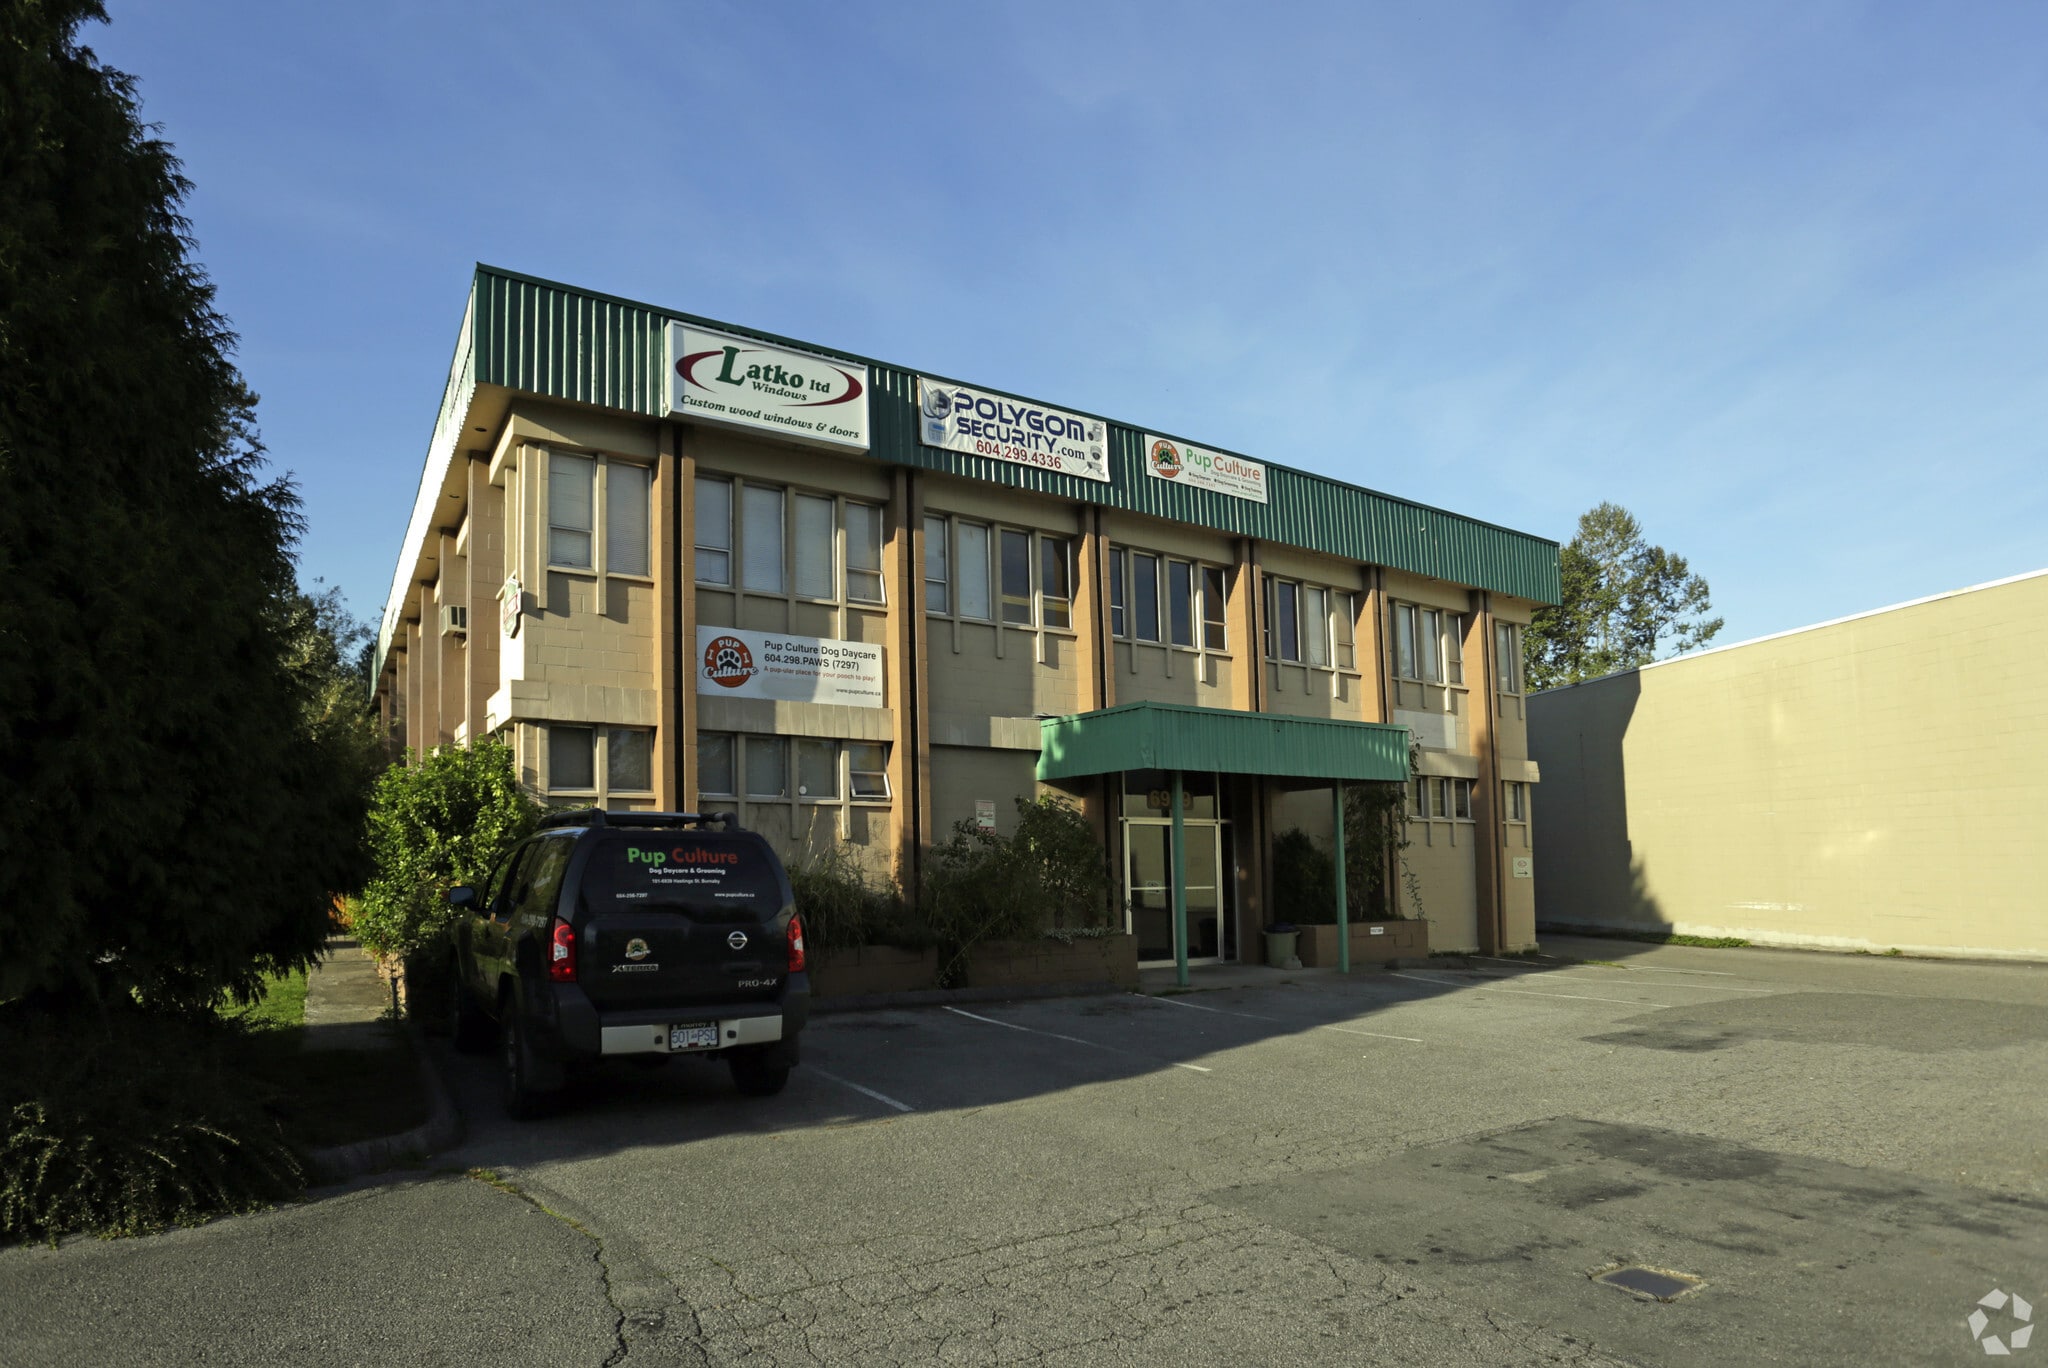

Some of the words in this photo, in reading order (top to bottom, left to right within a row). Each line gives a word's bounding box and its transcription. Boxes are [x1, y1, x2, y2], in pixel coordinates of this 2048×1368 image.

[716, 346, 804, 388] Latko
[810, 379, 830, 394] ltd
[752, 382, 808, 401] Windows
[681, 395, 726, 413] Custom
[729, 406, 761, 419] wood
[764, 412, 813, 430] windows
[816, 422, 827, 432] &
[829, 425, 859, 439] doors
[957, 416, 1057, 454] SECURITY
[976, 440, 1061, 469] 604.299.4336
[1186, 448, 1212, 472] Pup
[1214, 456, 1260, 480] Culture
[718, 639, 740, 649] PUP
[764, 640, 782, 651] Pup
[785, 643, 818, 654] Culture
[821, 646, 839, 657] Dog
[842, 648, 877, 660] Daycare
[764, 654, 829, 667] 604.298.PAWS
[832, 659, 859, 671] (7297)
[702, 665, 759, 679] Culture
[770, 667, 794, 675] pup-ular
[837, 672, 854, 680] pooch
[836, 688, 881, 696] www.pupculture.ca
[1150, 790, 1191, 808] 699
[627, 848, 666, 867] Pup
[672, 848, 738, 864] Culture
[738, 978, 777, 987] PRO-4X
[672, 1030, 689, 1044] 501
[697, 1029, 717, 1041] PSD
